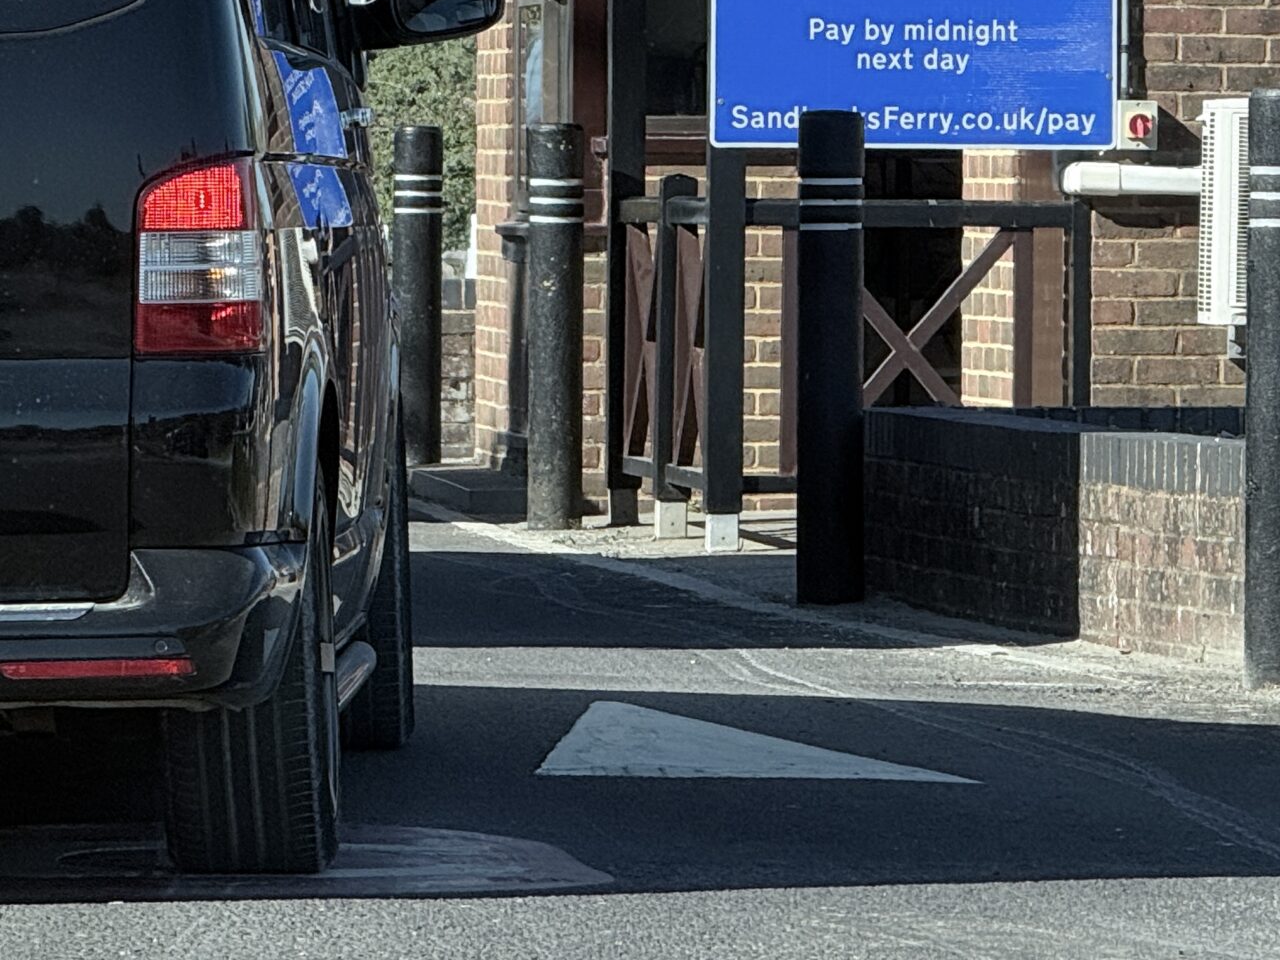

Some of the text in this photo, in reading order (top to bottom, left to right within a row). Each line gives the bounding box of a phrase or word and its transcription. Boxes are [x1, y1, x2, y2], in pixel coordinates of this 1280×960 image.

[809, 18, 1018, 46] Pay by midnight
[856, 48, 970, 75] next day
[731, 105, 1096, 136] SandsFerry.co.uk/pay
